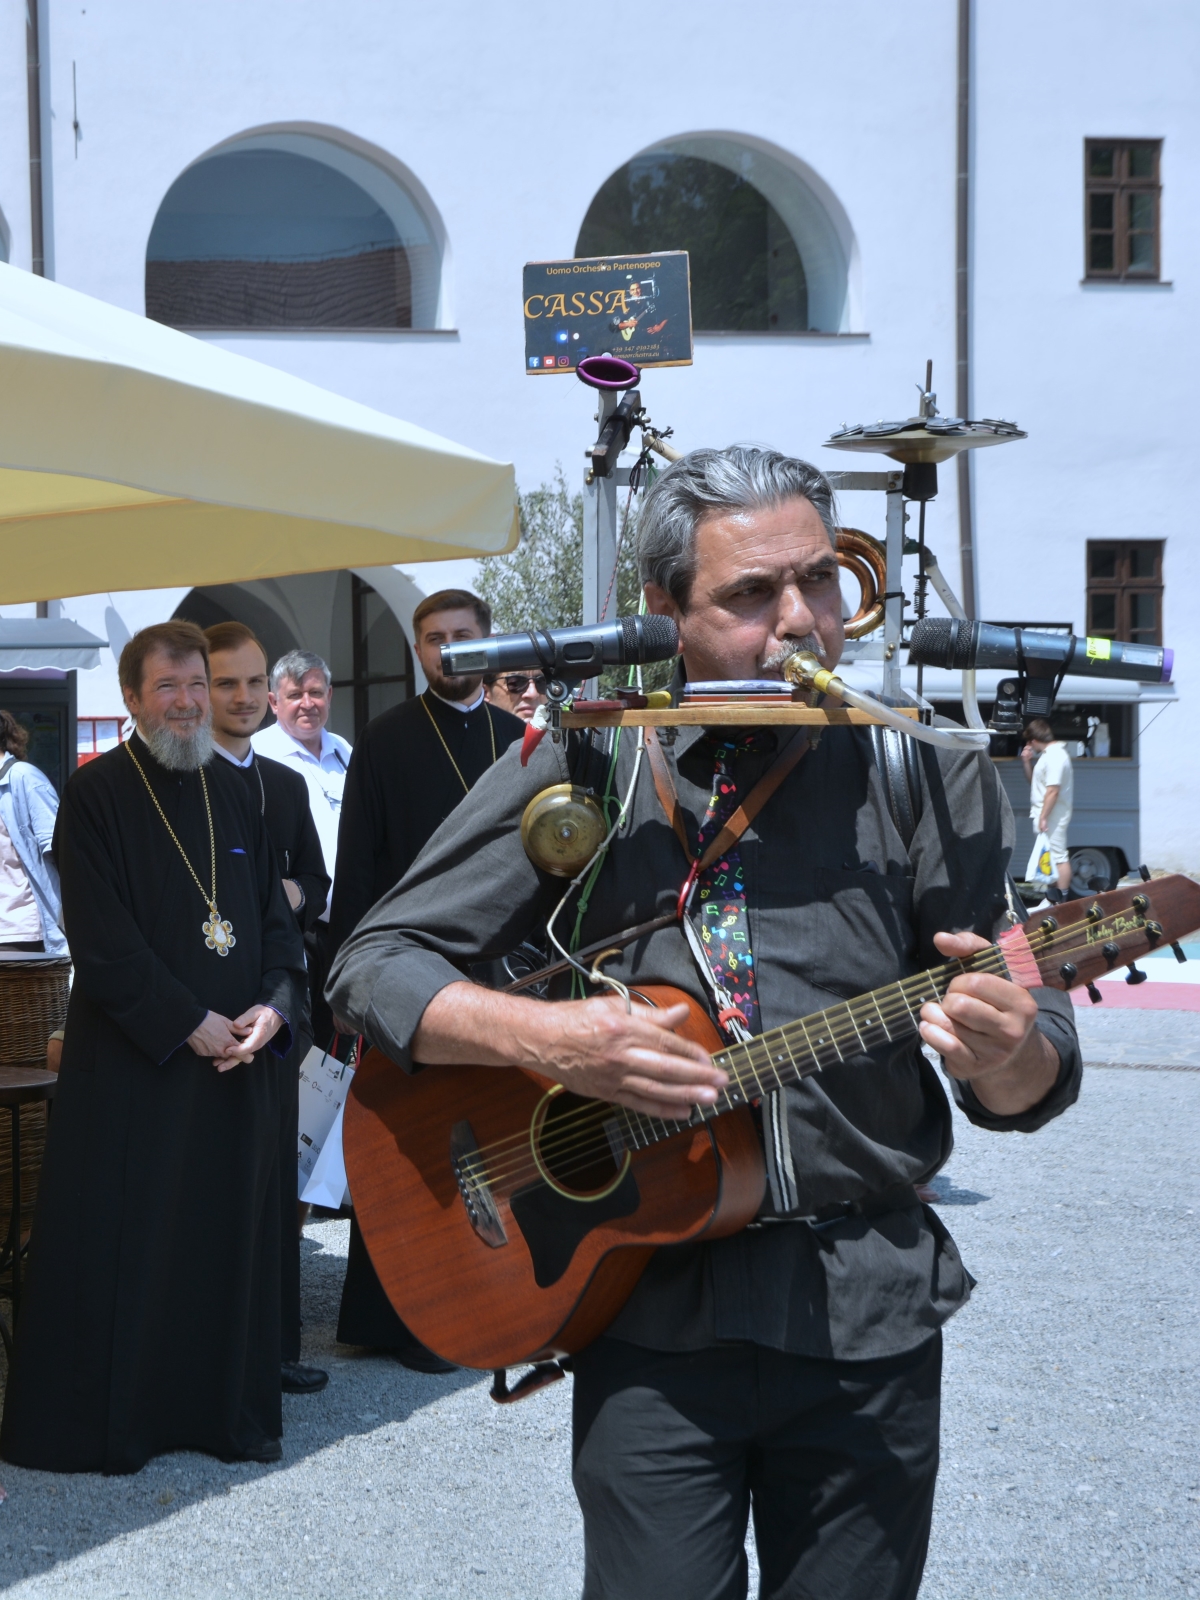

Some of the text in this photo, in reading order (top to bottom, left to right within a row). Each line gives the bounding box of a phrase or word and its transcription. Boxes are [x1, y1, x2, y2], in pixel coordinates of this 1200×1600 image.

[546, 266, 571, 275] Uomo
[613, 261, 661, 271] Partenopeo
[524, 289, 630, 319] CASSA
